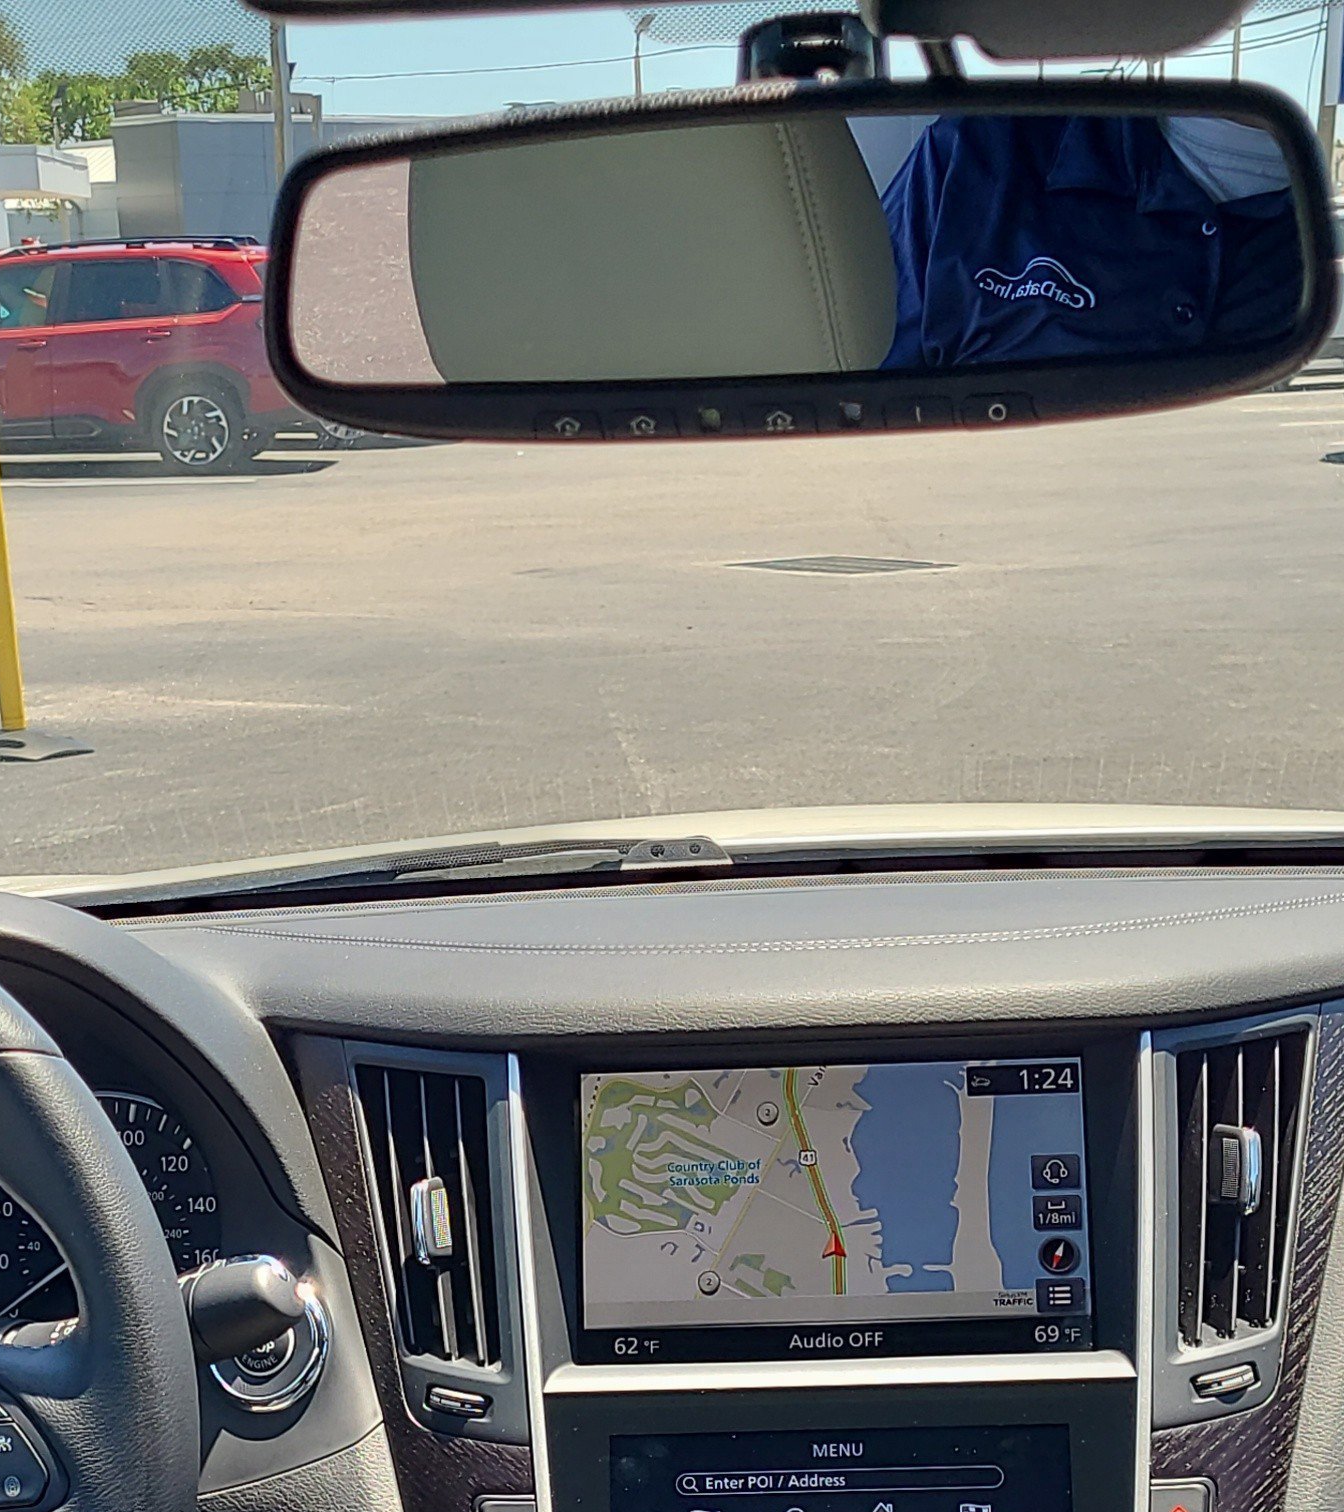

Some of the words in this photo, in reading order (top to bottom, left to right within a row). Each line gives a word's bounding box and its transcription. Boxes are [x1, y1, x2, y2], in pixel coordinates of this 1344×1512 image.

[1019, 1068, 1074, 1090] 1:24
[161, 1156, 188, 1172] 120
[667, 1162, 715, 1174] Country
[718, 1160, 745, 1171] Club
[748, 1159, 762, 1170] of
[803, 1154, 814, 1163] 41
[669, 1174, 720, 1187] Sarasota
[724, 1173, 760, 1185] Ponds
[188, 1197, 216, 1213] 140
[1038, 1212, 1076, 1225] 1/8mi
[27, 1242, 41, 1251] 40
[993, 1298, 1034, 1306] TRAFFIC
[789, 1332, 844, 1349] Audio
[849, 1332, 884, 1348] OFF
[1035, 1325, 1059, 1342] 69
[614, 1338, 639, 1355] 62
[242, 1354, 278, 1370] ENGINE
[812, 1443, 864, 1458] MENU
[705, 1477, 745, 1490] Enter
[748, 1476, 773, 1489] POI
[788, 1474, 846, 1488] Address
